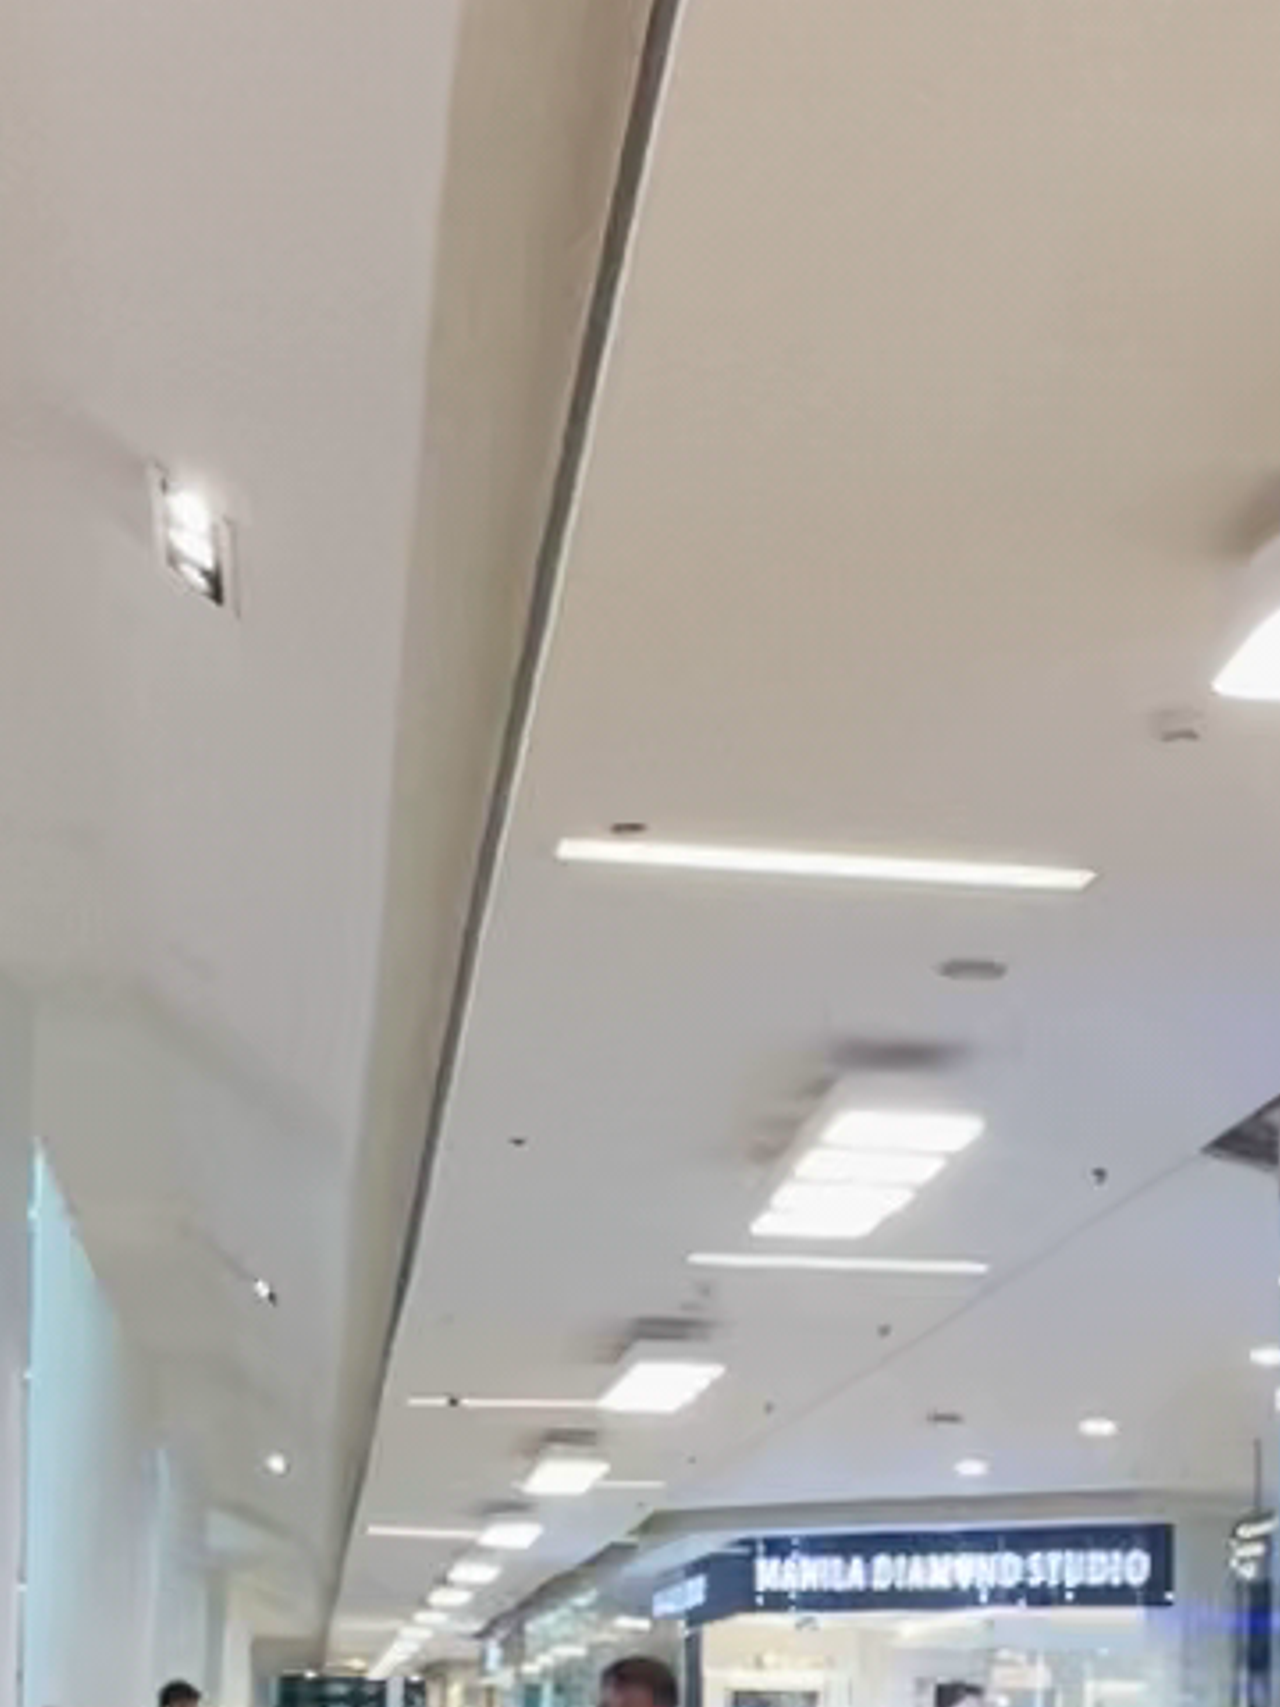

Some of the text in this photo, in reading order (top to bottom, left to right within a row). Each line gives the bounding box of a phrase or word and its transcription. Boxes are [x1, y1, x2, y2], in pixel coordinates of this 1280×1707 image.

[754, 1549, 1152, 1592] MANILA DIAMOND STUDIO
